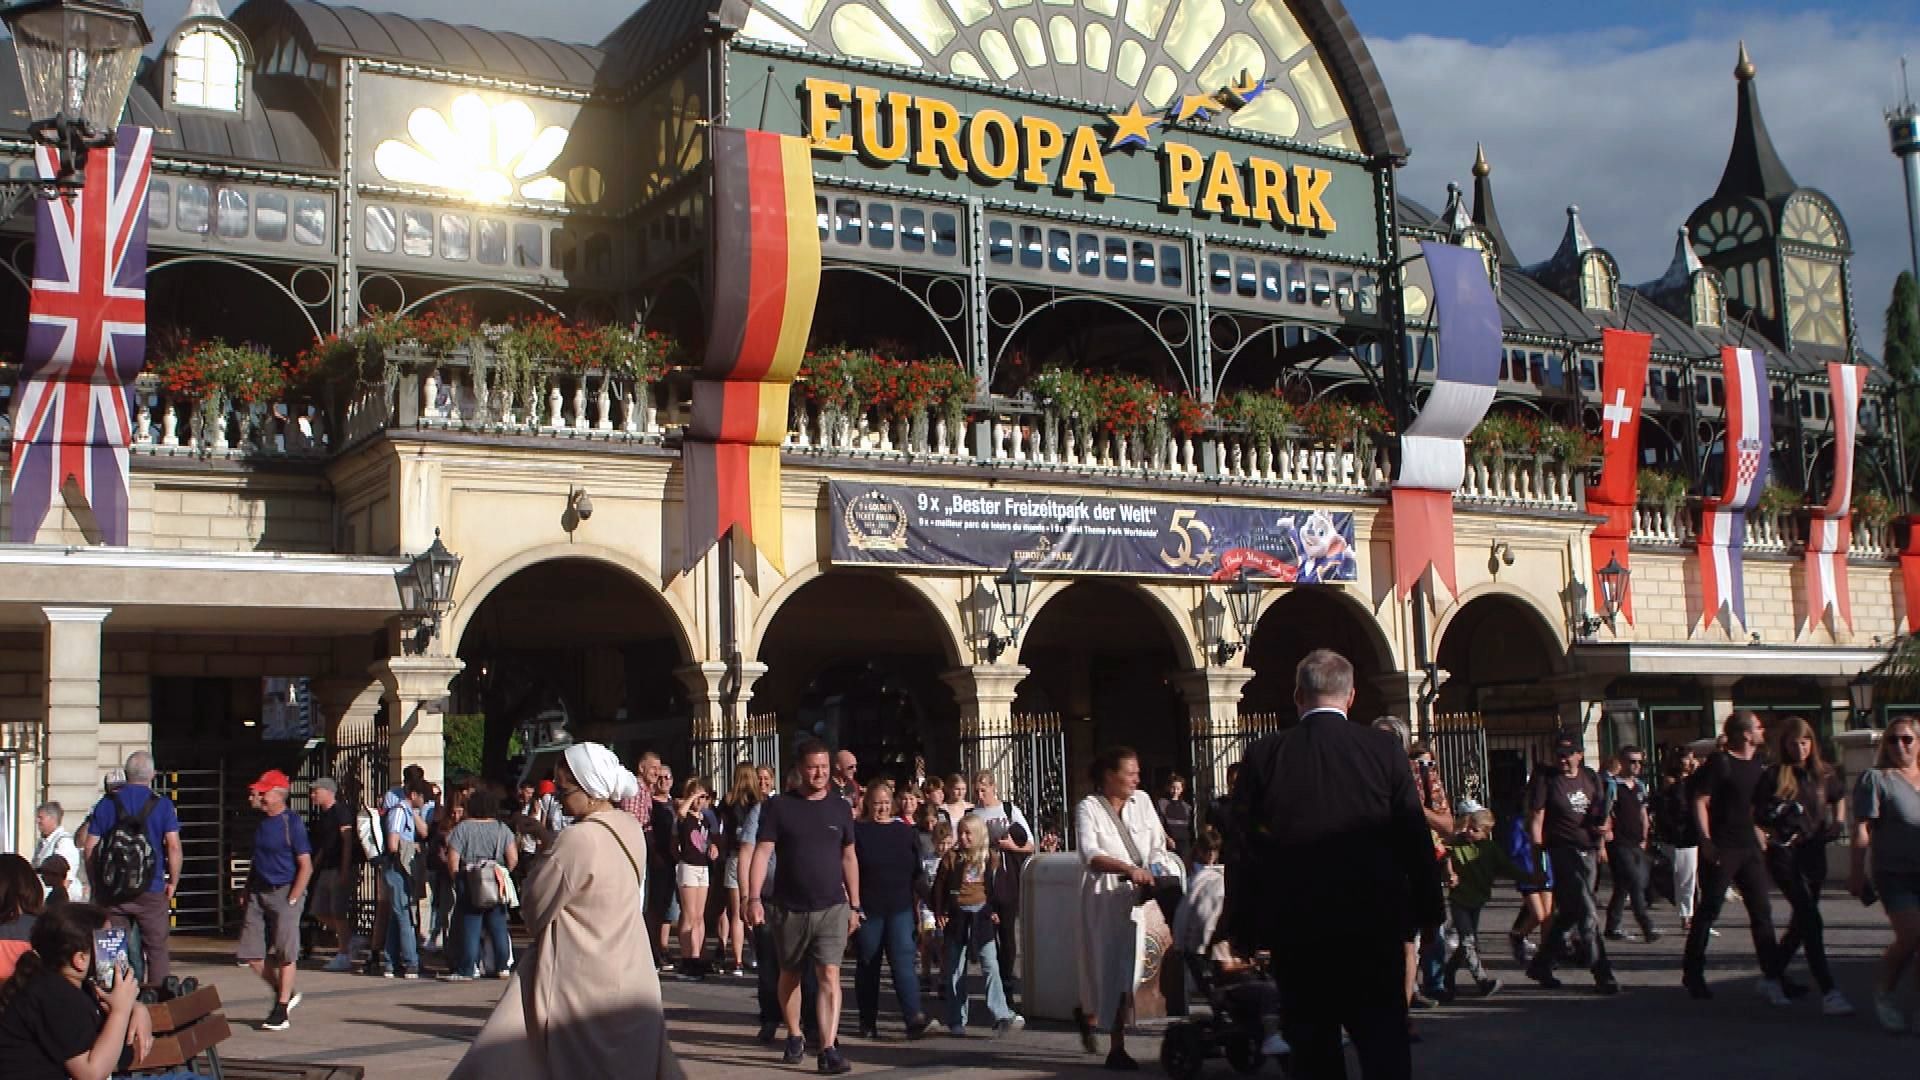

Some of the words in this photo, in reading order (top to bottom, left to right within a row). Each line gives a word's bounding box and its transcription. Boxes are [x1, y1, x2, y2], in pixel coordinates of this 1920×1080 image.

[804, 77, 1115, 196] EUROPA
[1165, 141, 1337, 232] PARK
[917, 492, 928, 511] 9
[929, 497, 940, 512] x
[1004, 497, 1090, 522] Freizeitpark
[1093, 503, 1117, 521] der
[1107, 526, 1122, 535] Park
